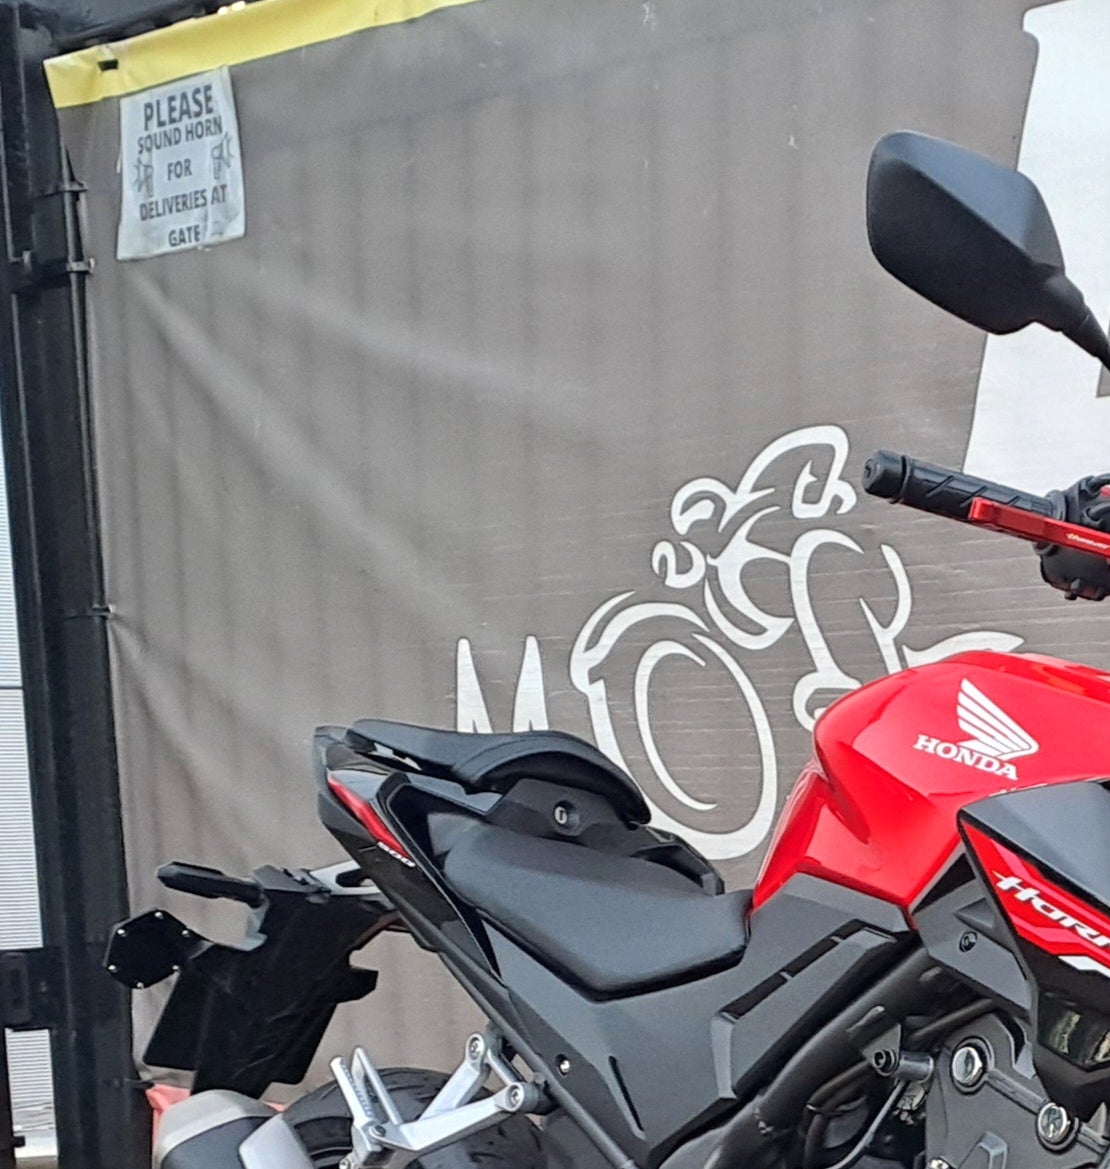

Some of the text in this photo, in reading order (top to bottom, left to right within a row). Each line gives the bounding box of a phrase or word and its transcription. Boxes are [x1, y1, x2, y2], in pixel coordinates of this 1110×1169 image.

[143, 84, 214, 131] PLEASE
[137, 115, 223, 155] SOUND HORN
[167, 158, 192, 181] FOR
[139, 184, 228, 221] DELIVERIES AT
[168, 225, 200, 247] GATE
[912, 733, 1018, 781] HONDA
